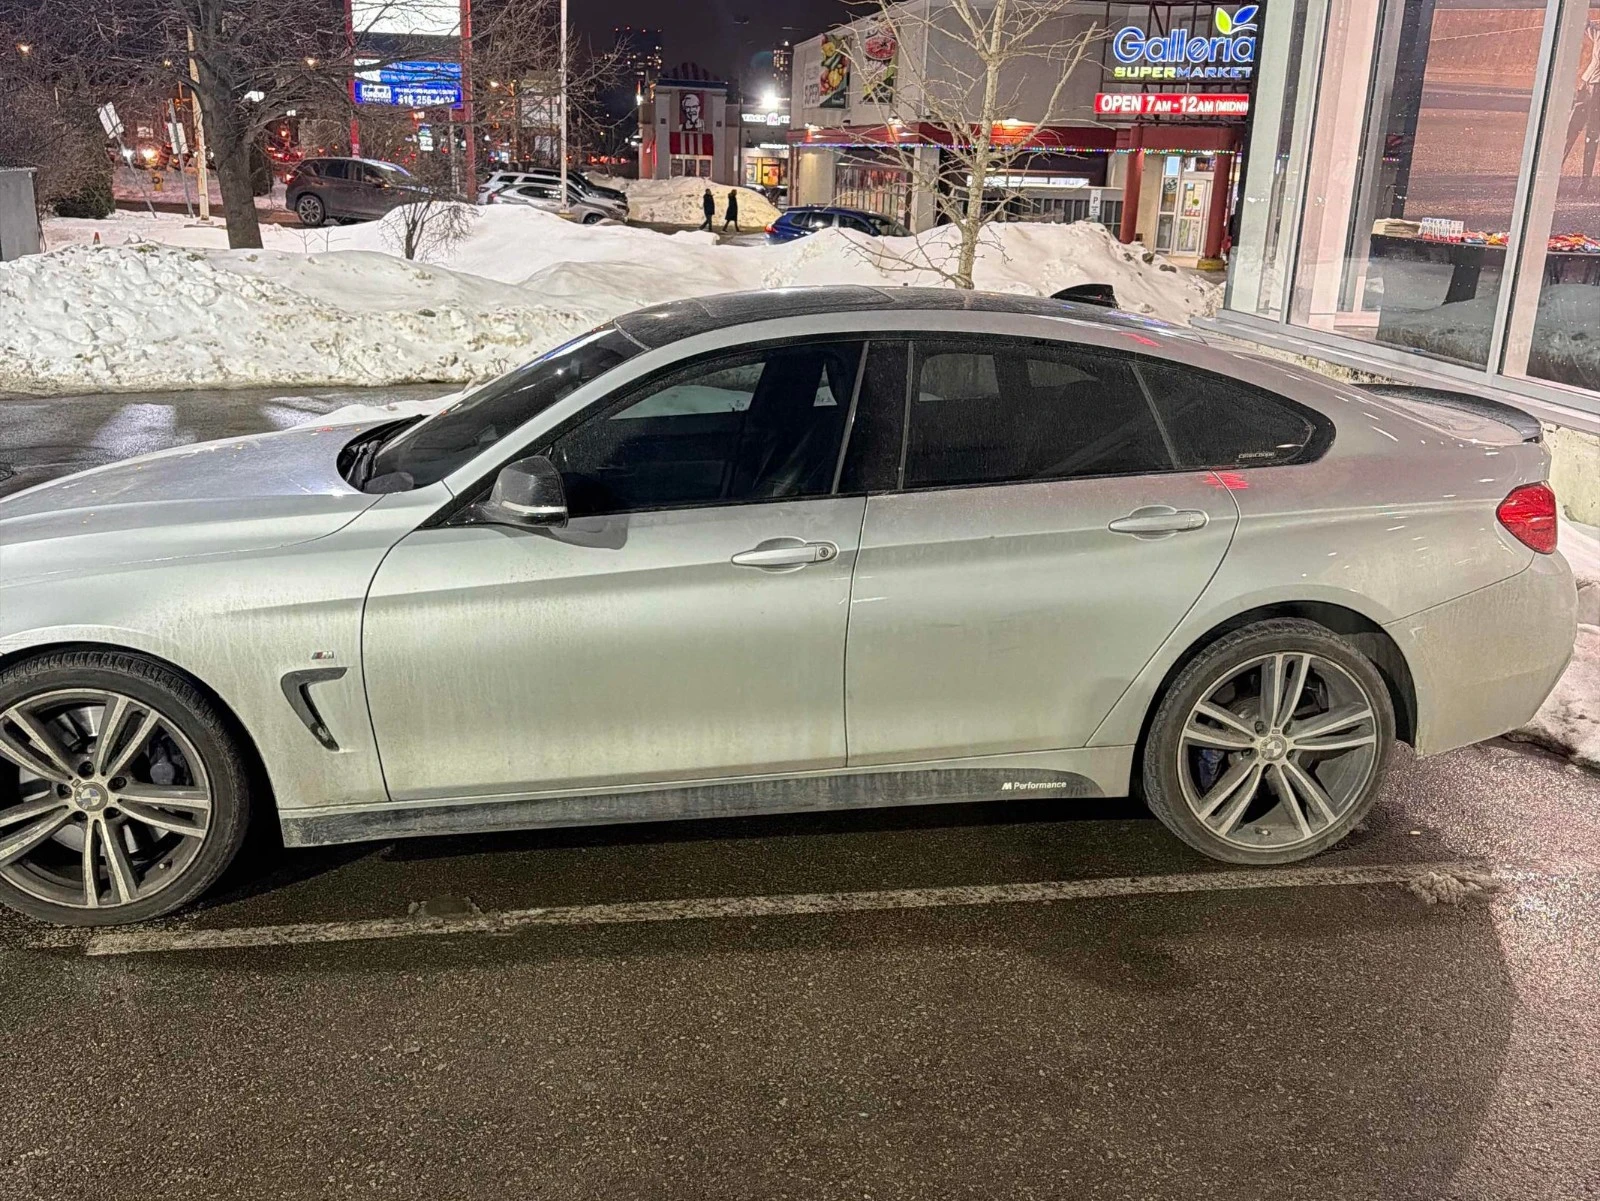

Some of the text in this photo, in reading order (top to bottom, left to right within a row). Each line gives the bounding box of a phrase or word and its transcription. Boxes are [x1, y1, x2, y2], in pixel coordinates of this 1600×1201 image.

[1113, 26, 1257, 63] Galleria
[1114, 66, 1253, 79] SUPERMARKET
[1101, 95, 1142, 112] OPEN
[1013, 781, 1067, 790] Performance
